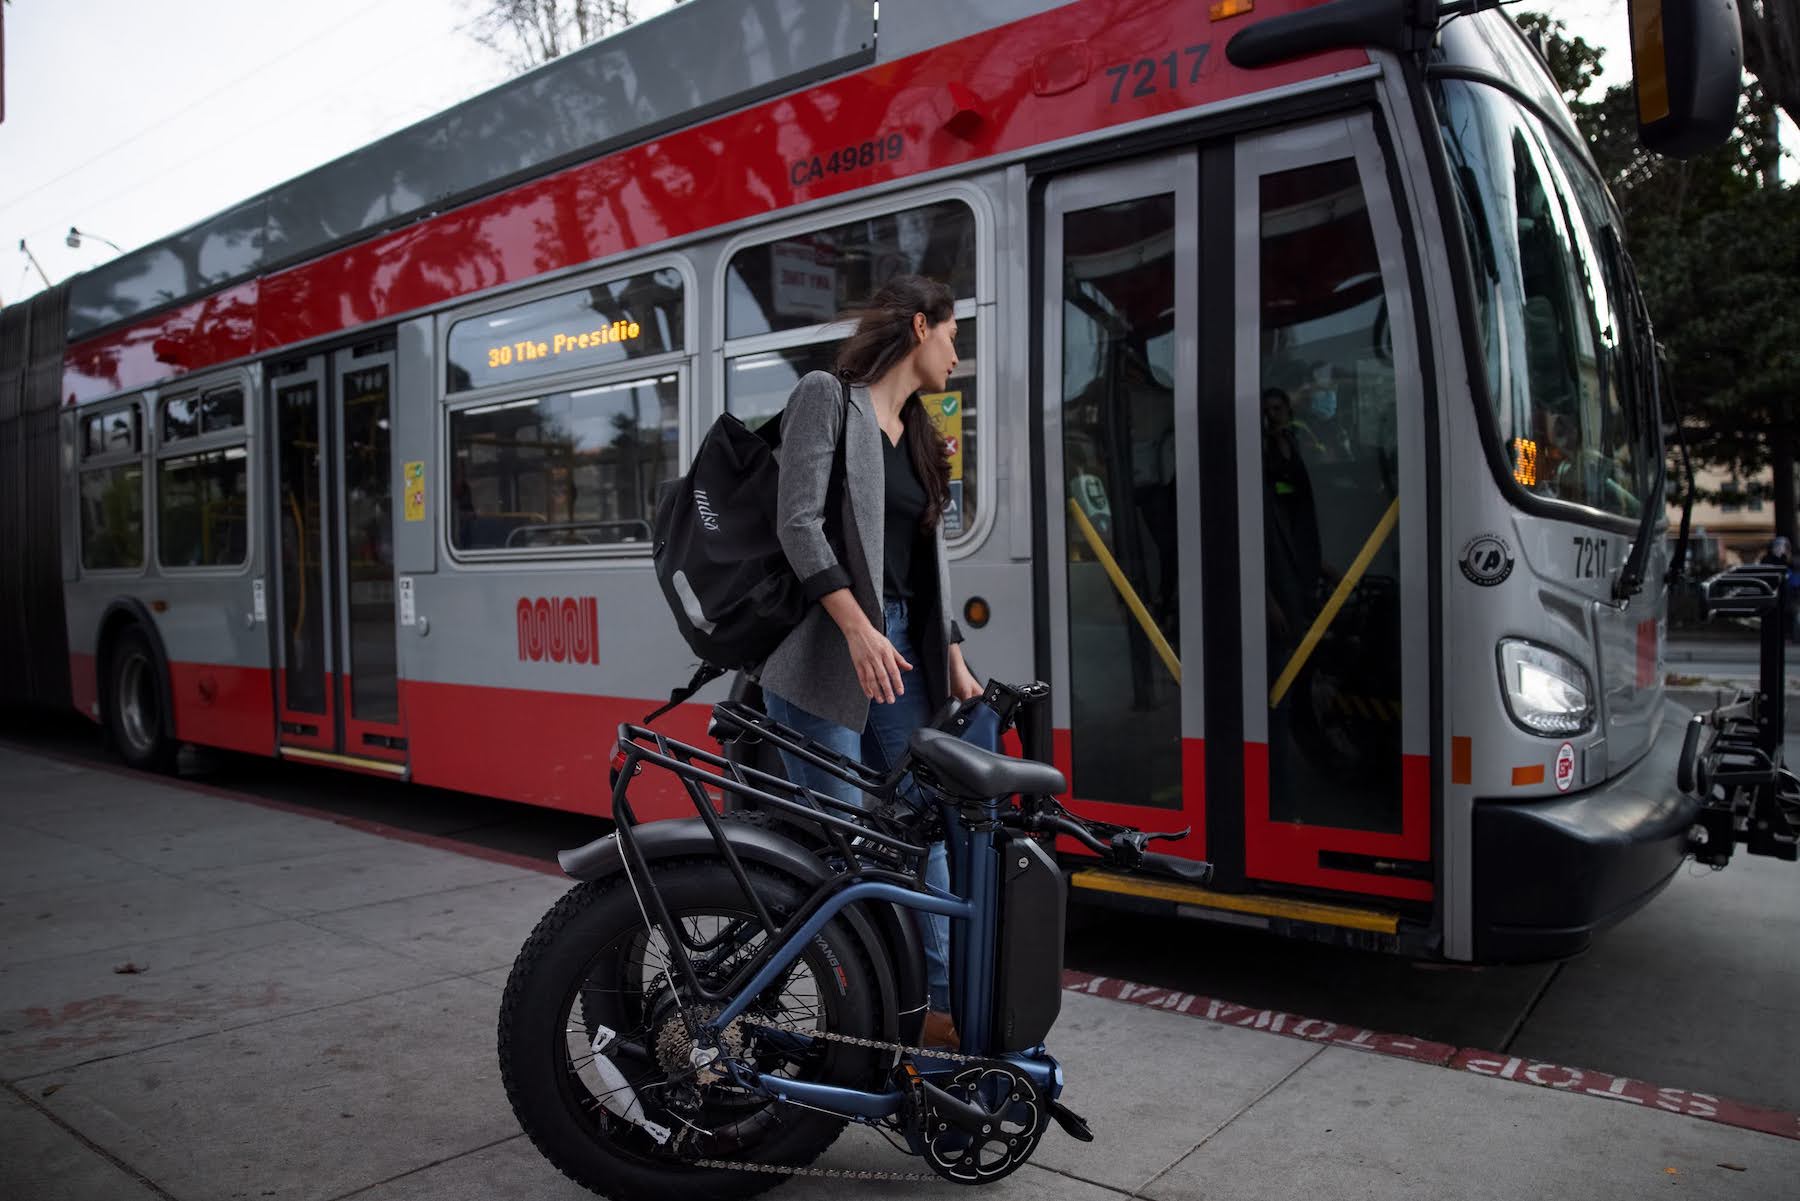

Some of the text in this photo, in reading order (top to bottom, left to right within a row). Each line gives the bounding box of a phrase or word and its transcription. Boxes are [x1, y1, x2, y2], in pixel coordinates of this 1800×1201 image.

[1106, 43, 1211, 103] 7217
[791, 134, 904, 187] CA49819
[488, 319, 641, 368] 30 The Presidio
[1573, 536, 1608, 579] 7217
[1466, 1058, 1720, 1117] STOP
